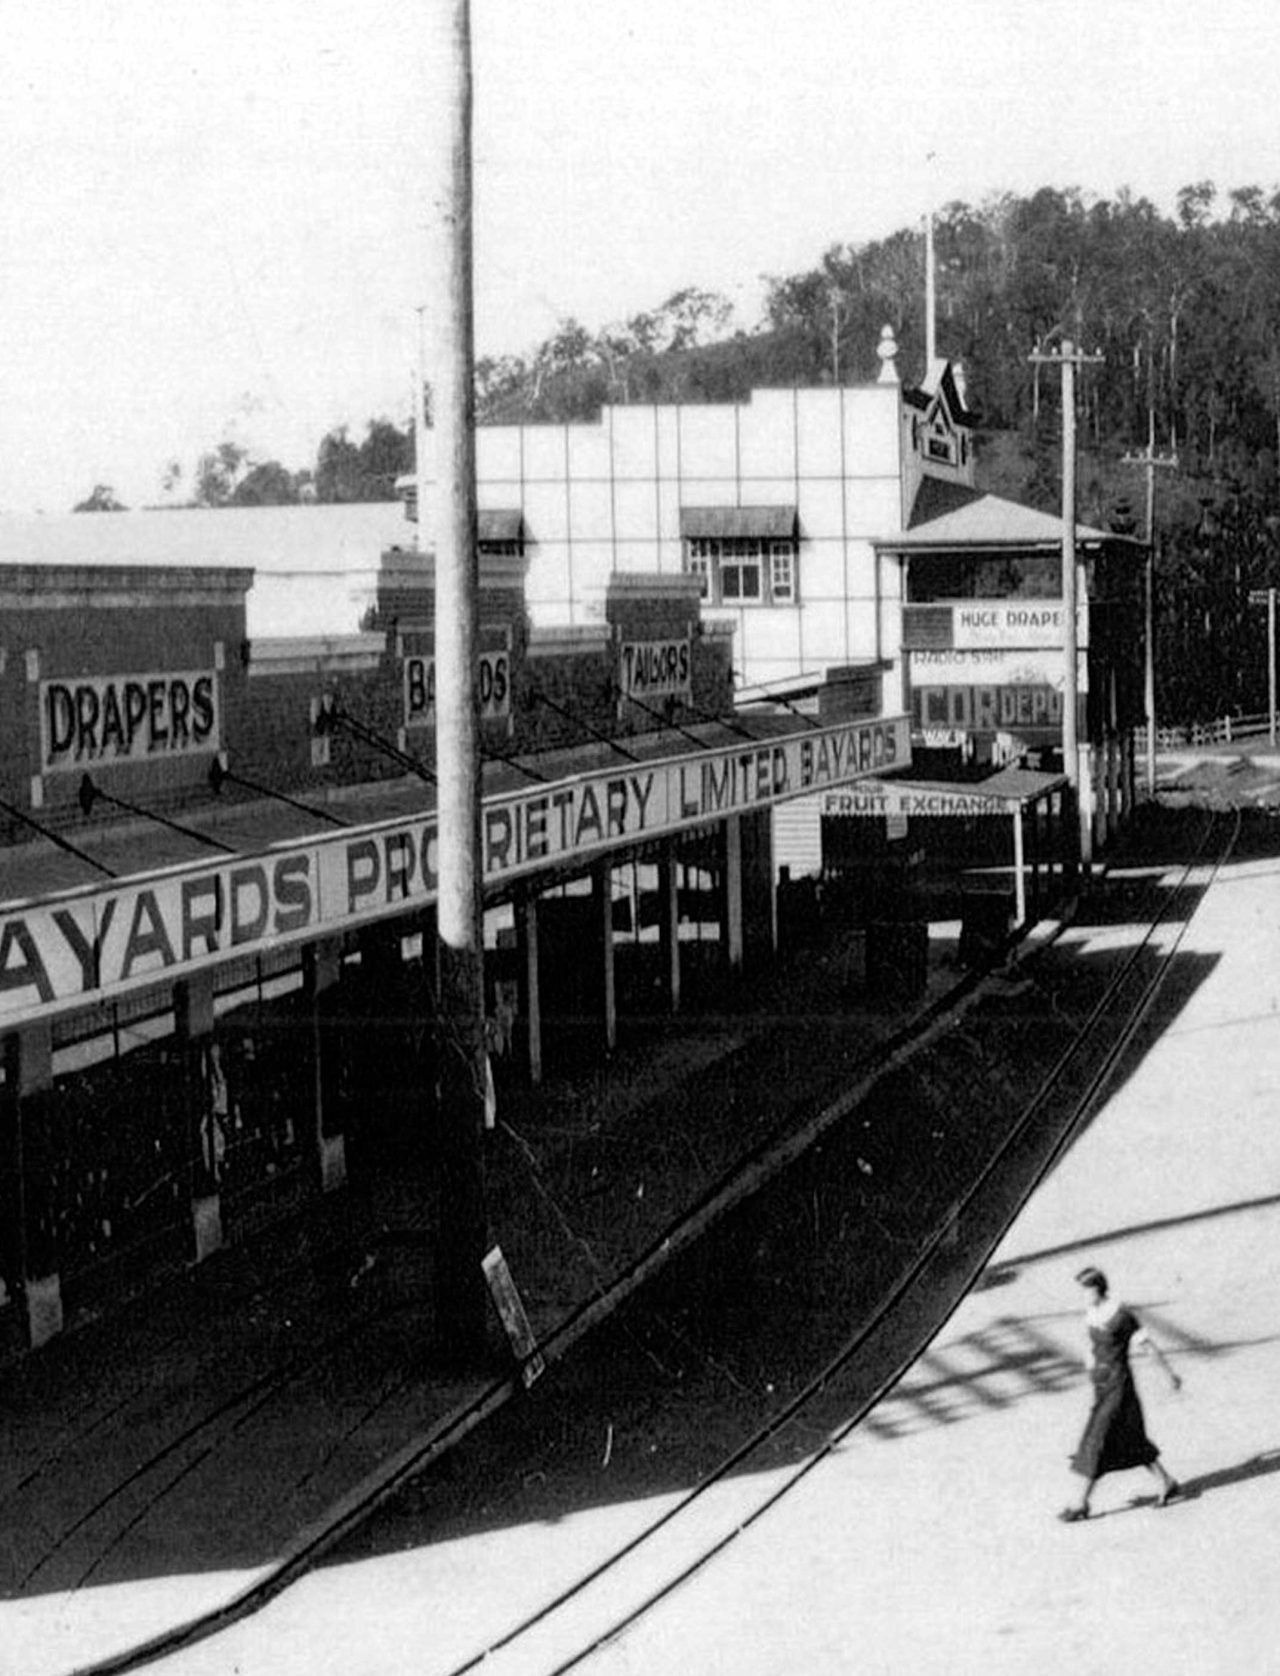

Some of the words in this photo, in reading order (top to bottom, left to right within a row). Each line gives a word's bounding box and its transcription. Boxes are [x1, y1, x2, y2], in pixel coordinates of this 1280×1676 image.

[960, 611, 997, 627] HUGE
[48, 677, 214, 756] DRAPERS
[1000, 687, 1063, 724] DEPO
[825, 795, 888, 812] FRUIT
[901, 796, 1007, 812] EXCHANGE
[0, 855, 312, 1002] AYARDS
[347, 773, 654, 912] PRORIETARY
[801, 724, 896, 786] BAYARDS
